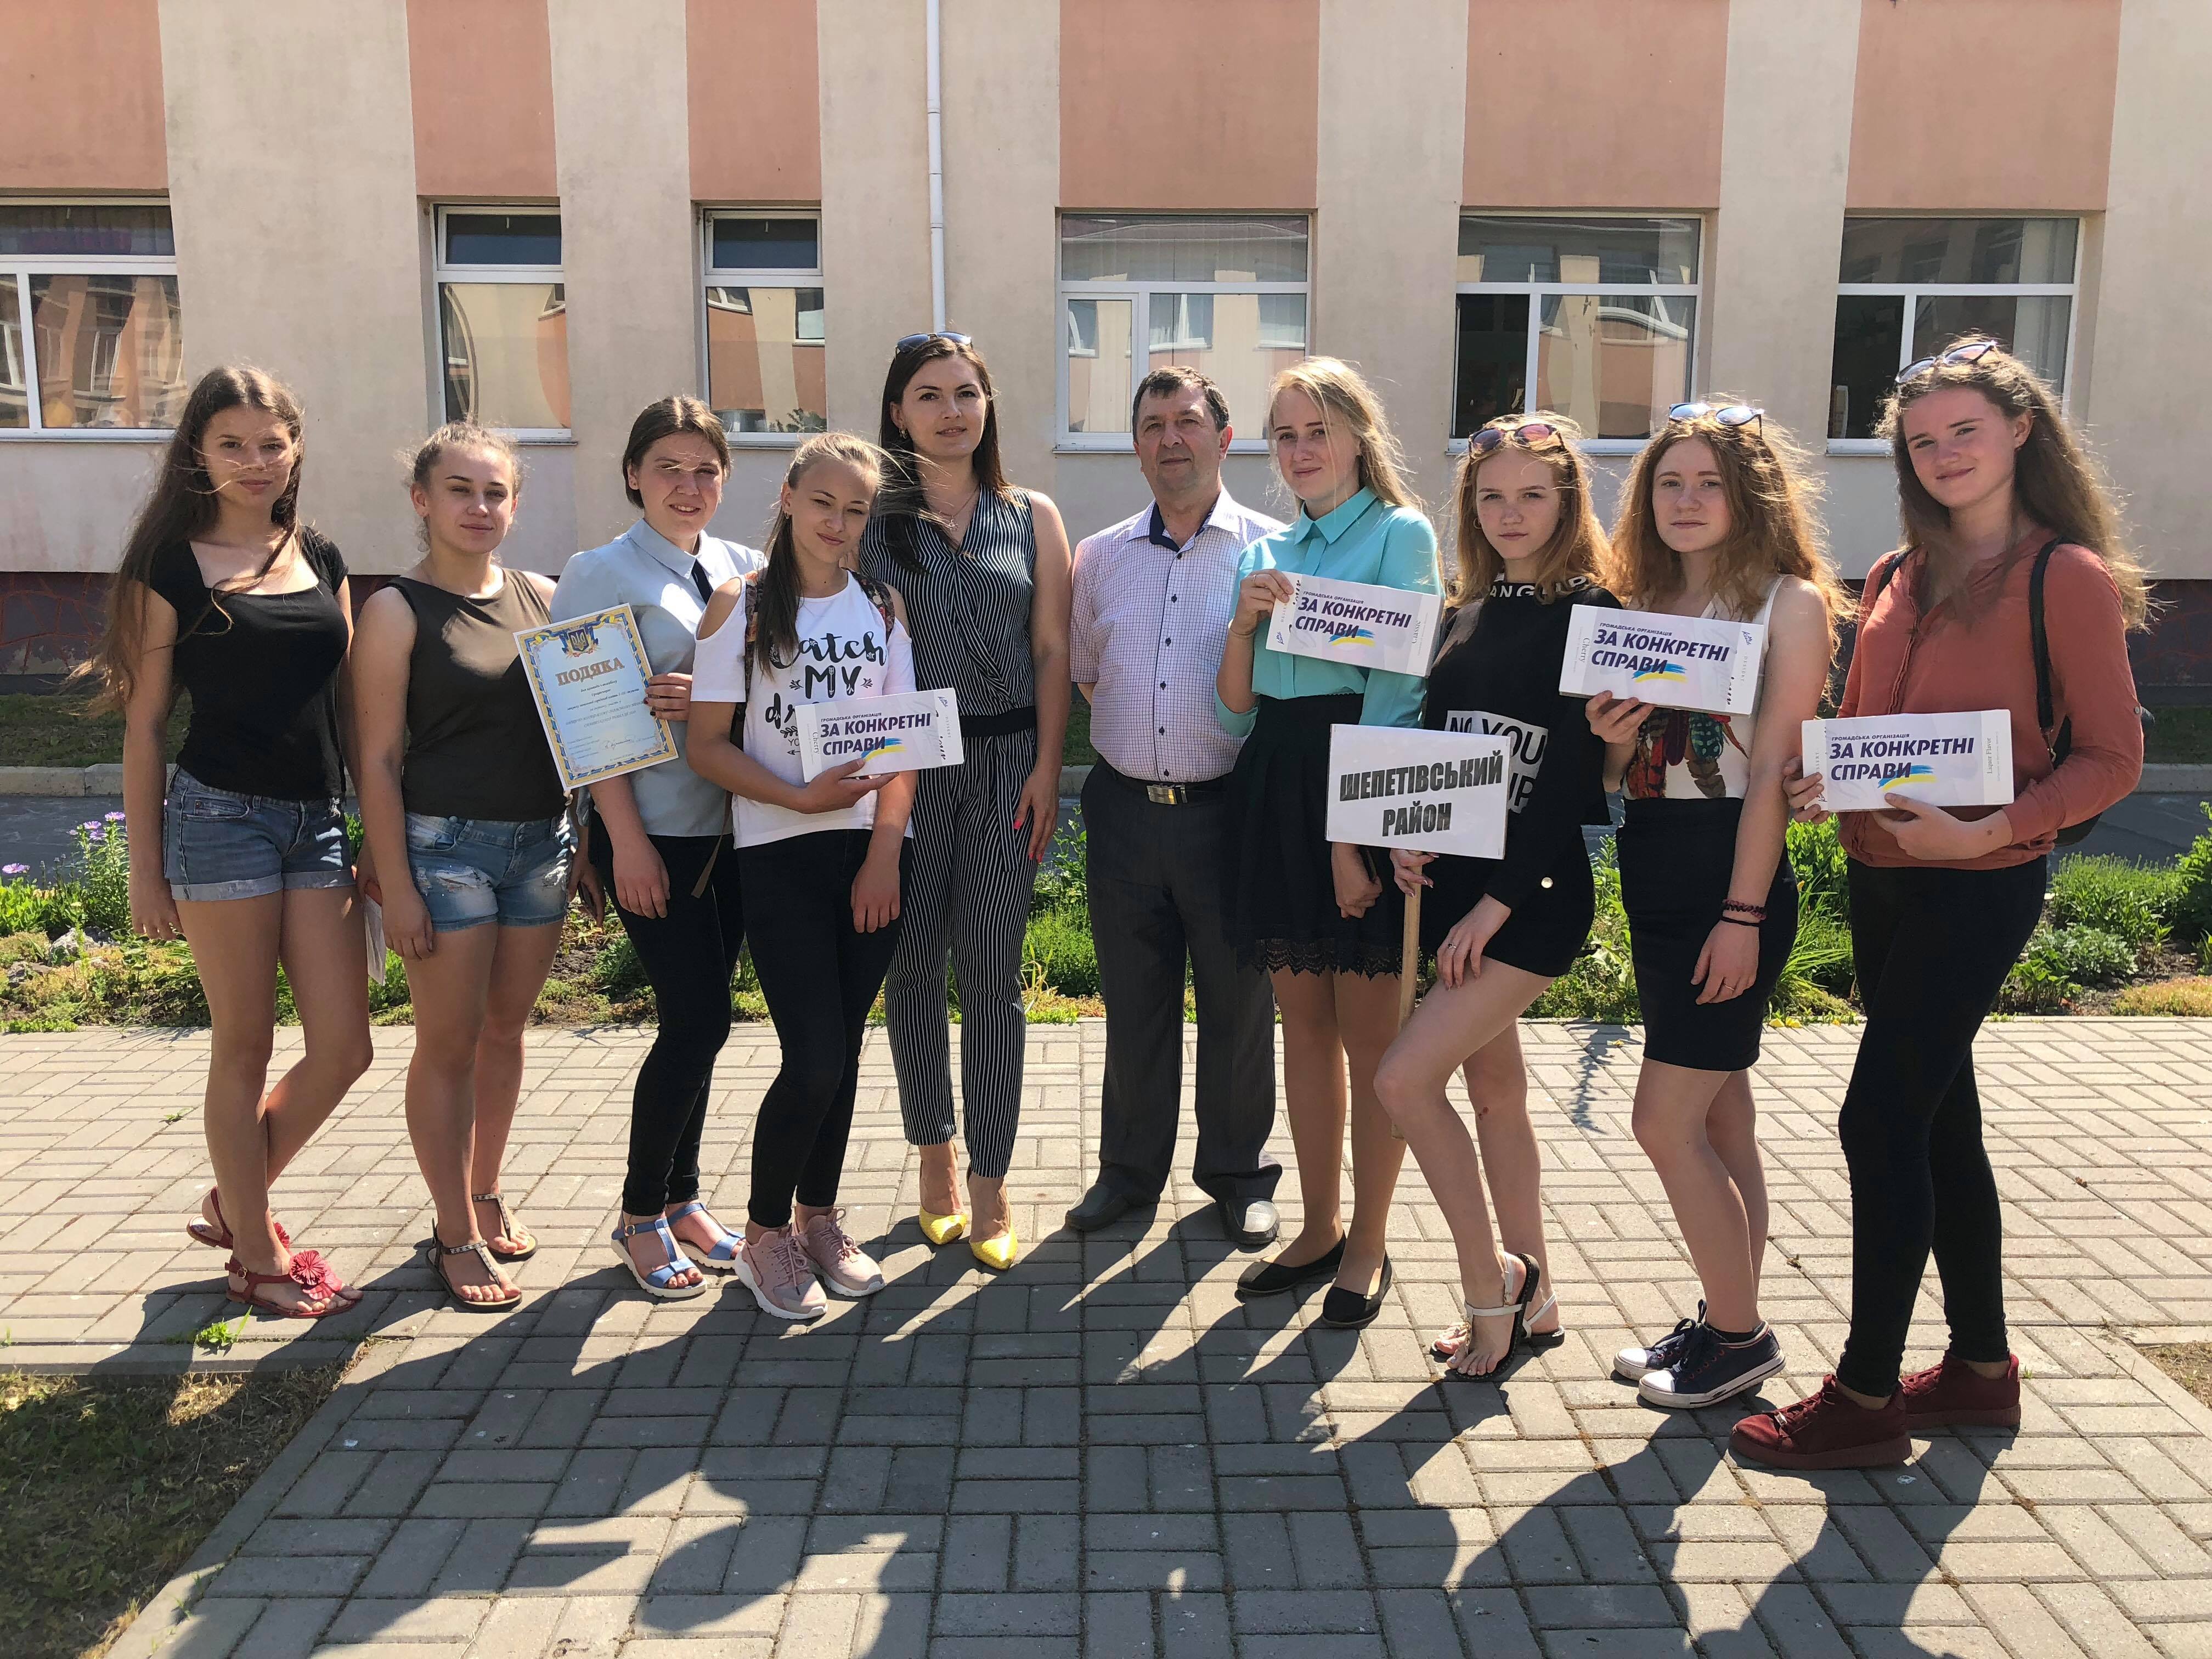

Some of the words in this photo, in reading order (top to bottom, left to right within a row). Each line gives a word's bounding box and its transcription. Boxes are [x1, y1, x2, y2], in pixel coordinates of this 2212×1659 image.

[1304, 591, 1333, 599] ГРОМАДСЬКА
[1298, 597, 1317, 613] ЗА
[1321, 602, 1412, 628] КОНКРЕТНІ
[1295, 616, 1359, 638] СПРАВИ
[1600, 623, 1635, 631] ГРОМАДСЬКА
[1637, 627, 1672, 636] ОРГАНІЗАЦІЯ
[1578, 638, 1590, 663] Cherry
[1594, 629, 1618, 646] ЗА
[1623, 634, 1730, 662] КОНКРЕТНІ
[555, 657, 625, 686] ПОДЯКА
[1591, 650, 1668, 674] СПРАВИ
[805, 665, 862, 699] MY
[820, 723, 840, 738] ЗА
[844, 713, 931, 735] КОНКРЕТНІ
[812, 732, 820, 754] Cherry
[823, 736, 885, 755] СПРАВИ
[1830, 742, 1854, 760] ЗА
[1860, 737, 1974, 758] КОНКРЕТНІ
[1340, 750, 1503, 802] ШЕПЕТІВСЬКИЙ
[1831, 762, 1911, 781] СПРАВИ
[1382, 801, 1452, 837] РАЙОН
